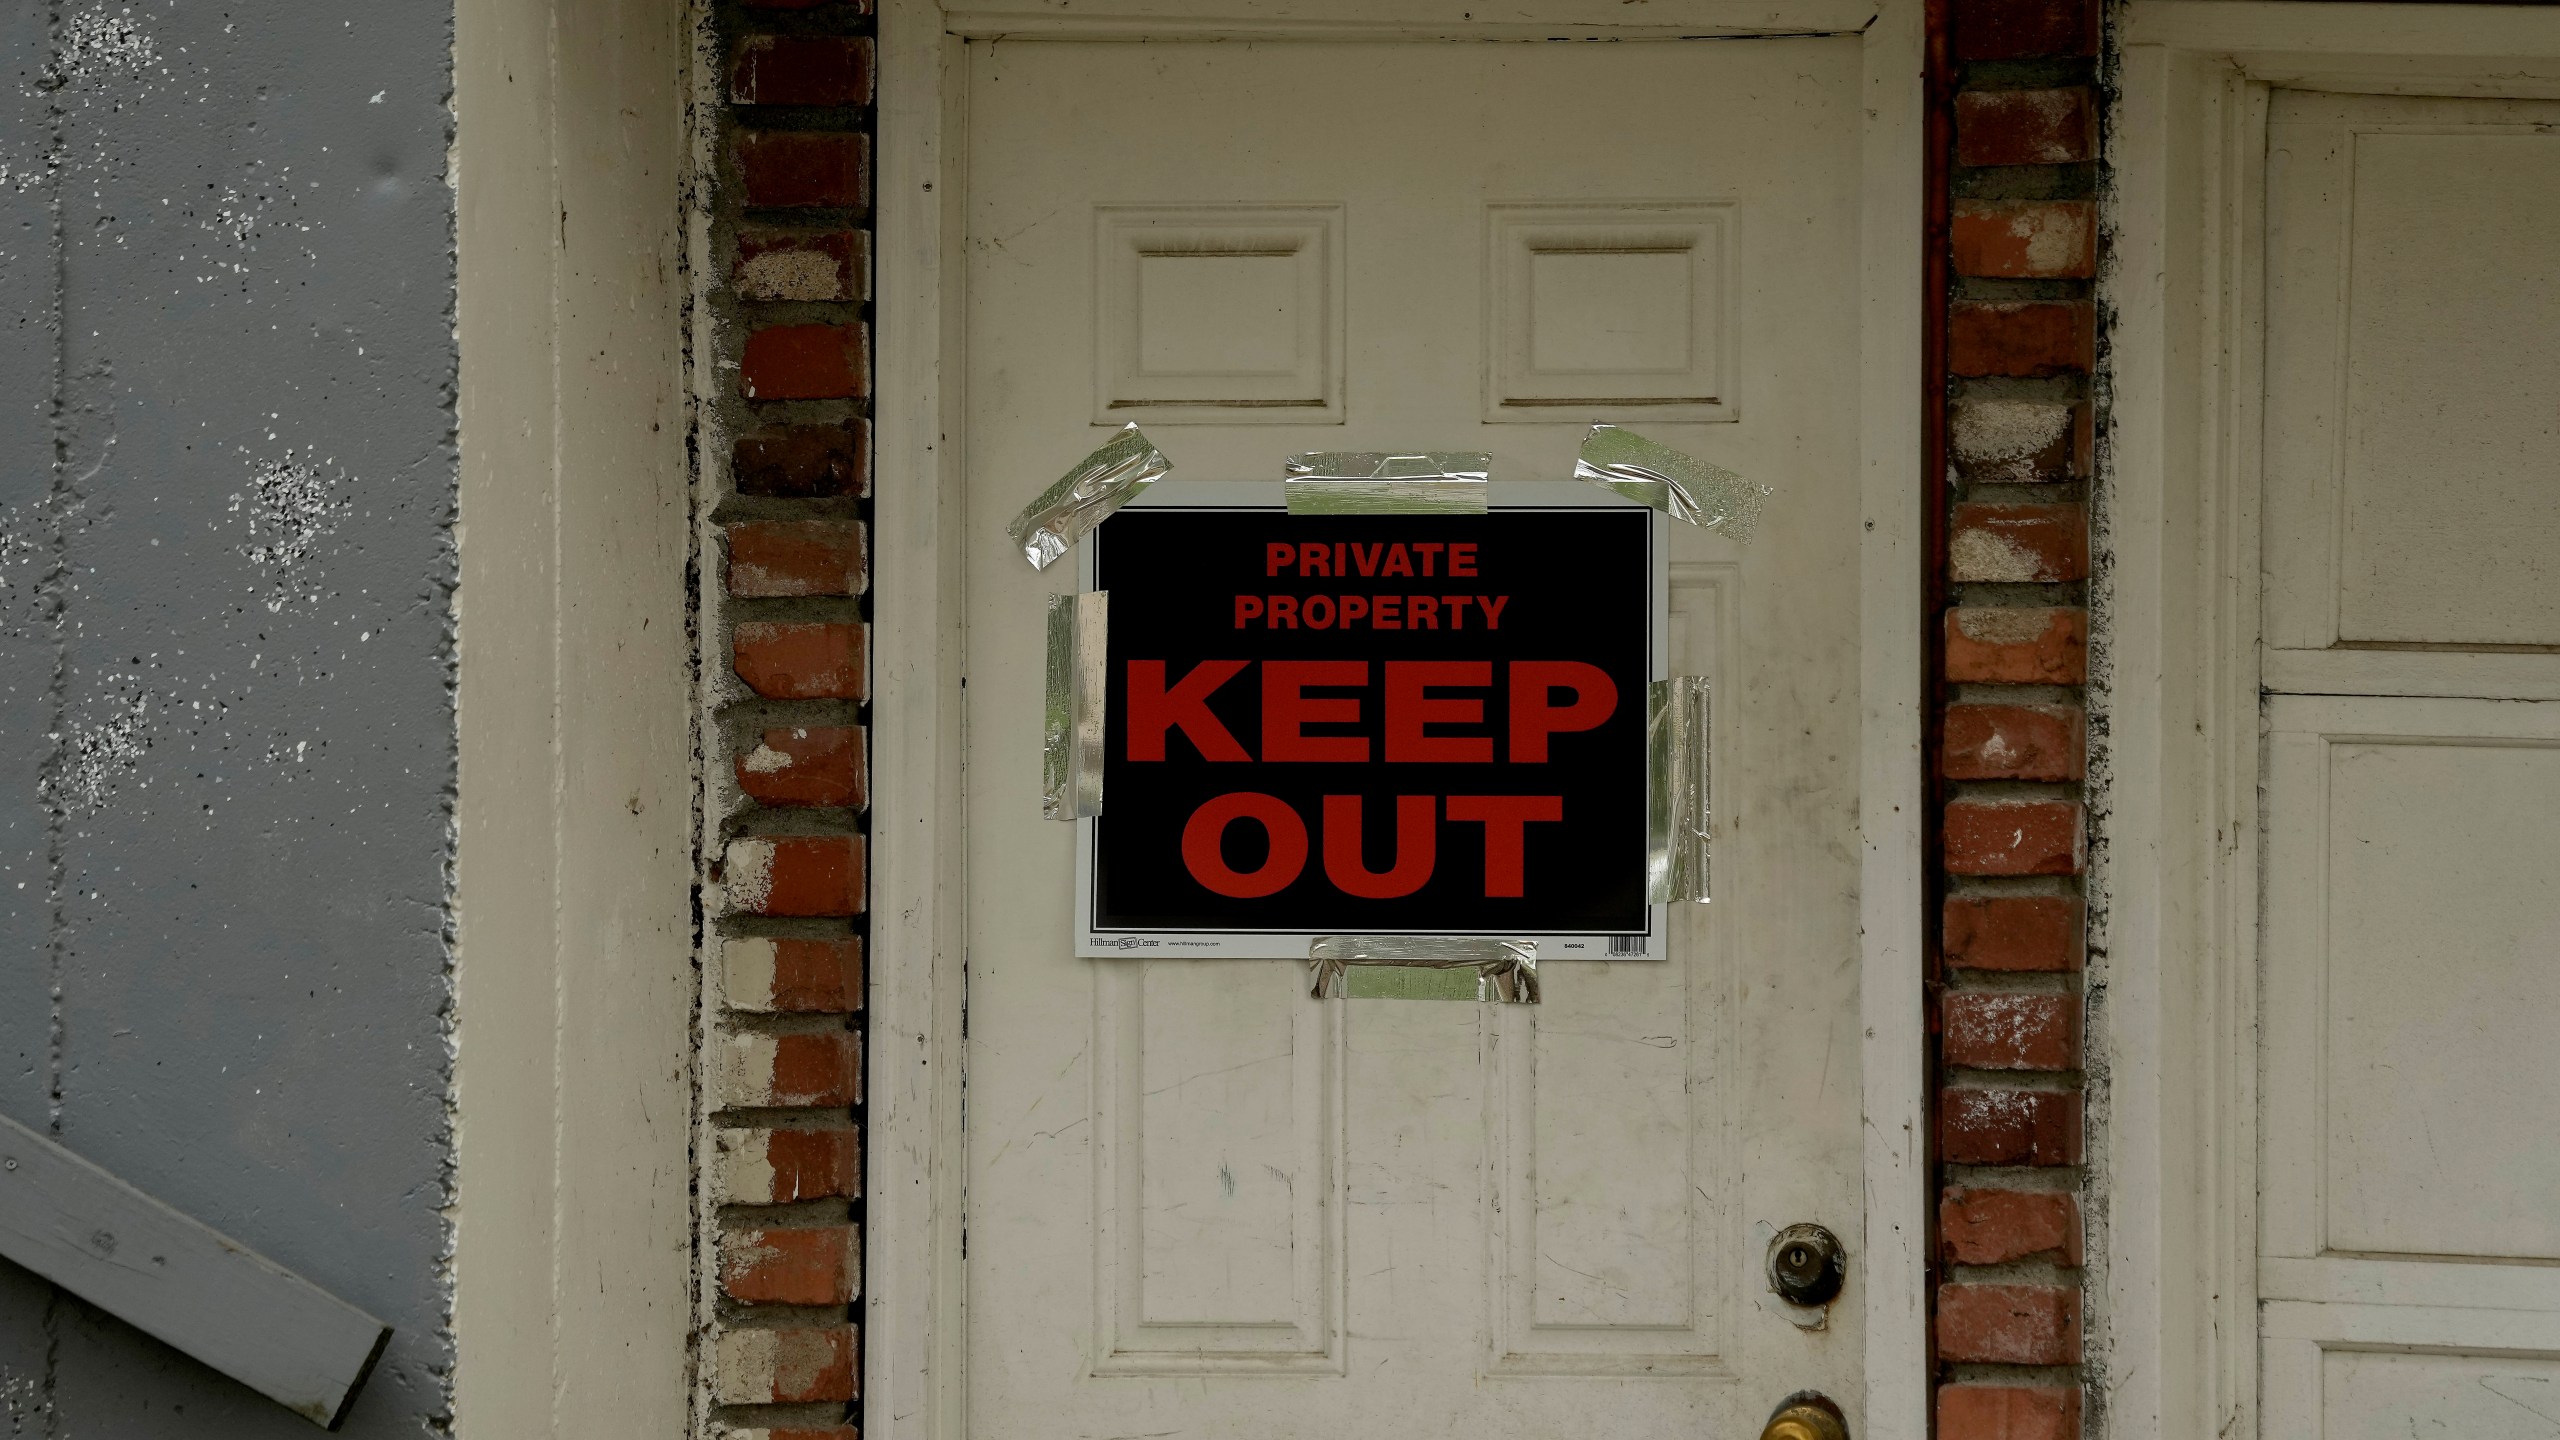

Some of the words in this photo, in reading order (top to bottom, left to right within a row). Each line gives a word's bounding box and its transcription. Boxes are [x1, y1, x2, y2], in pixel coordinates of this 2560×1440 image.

[1266, 542, 1478, 577] PRIVATE
[1234, 594, 1509, 630] PROPERTY
[1126, 659, 1619, 763] KEEP
[1181, 791, 1563, 899] OUT
[1090, 938, 1118, 946] Hillman
[1138, 938, 1160, 946] Center
